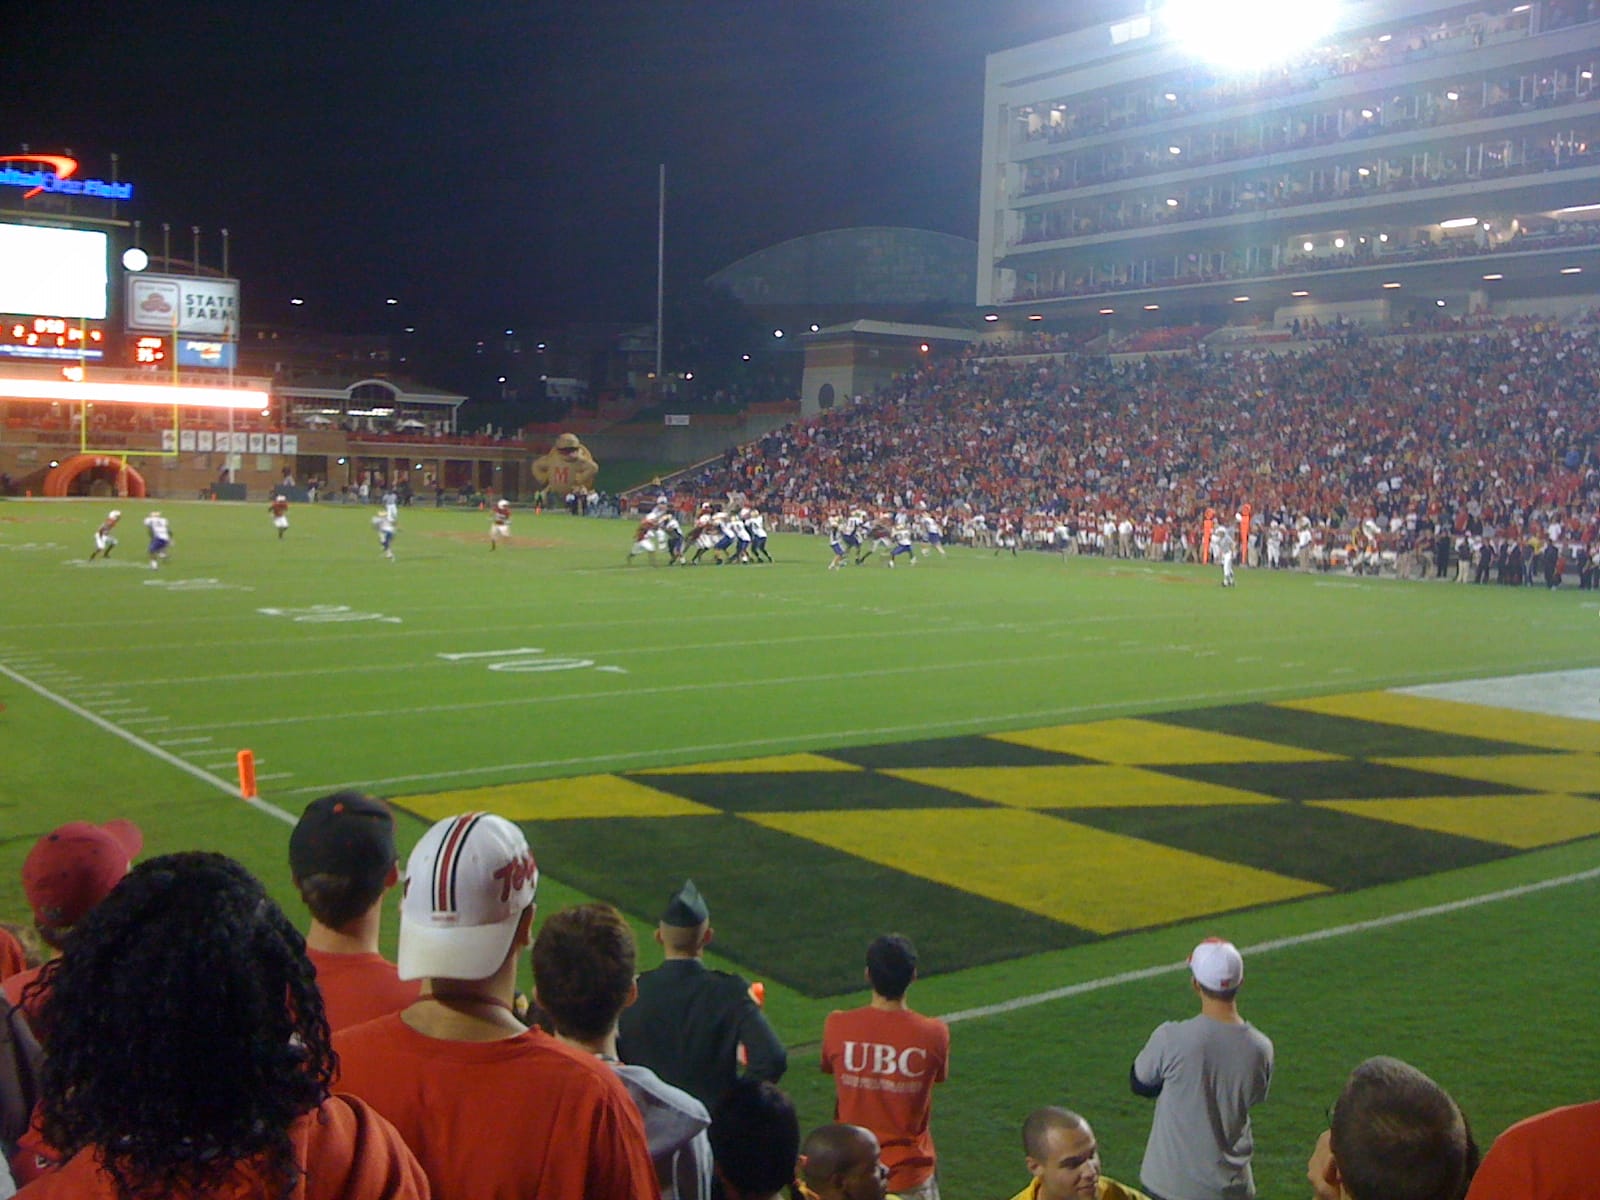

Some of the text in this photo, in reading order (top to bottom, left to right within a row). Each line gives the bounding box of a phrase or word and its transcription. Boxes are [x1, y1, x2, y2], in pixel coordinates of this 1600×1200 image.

[186, 294, 235, 307] STATE
[554, 466, 570, 485] M
[843, 1041, 927, 1078] UBC
